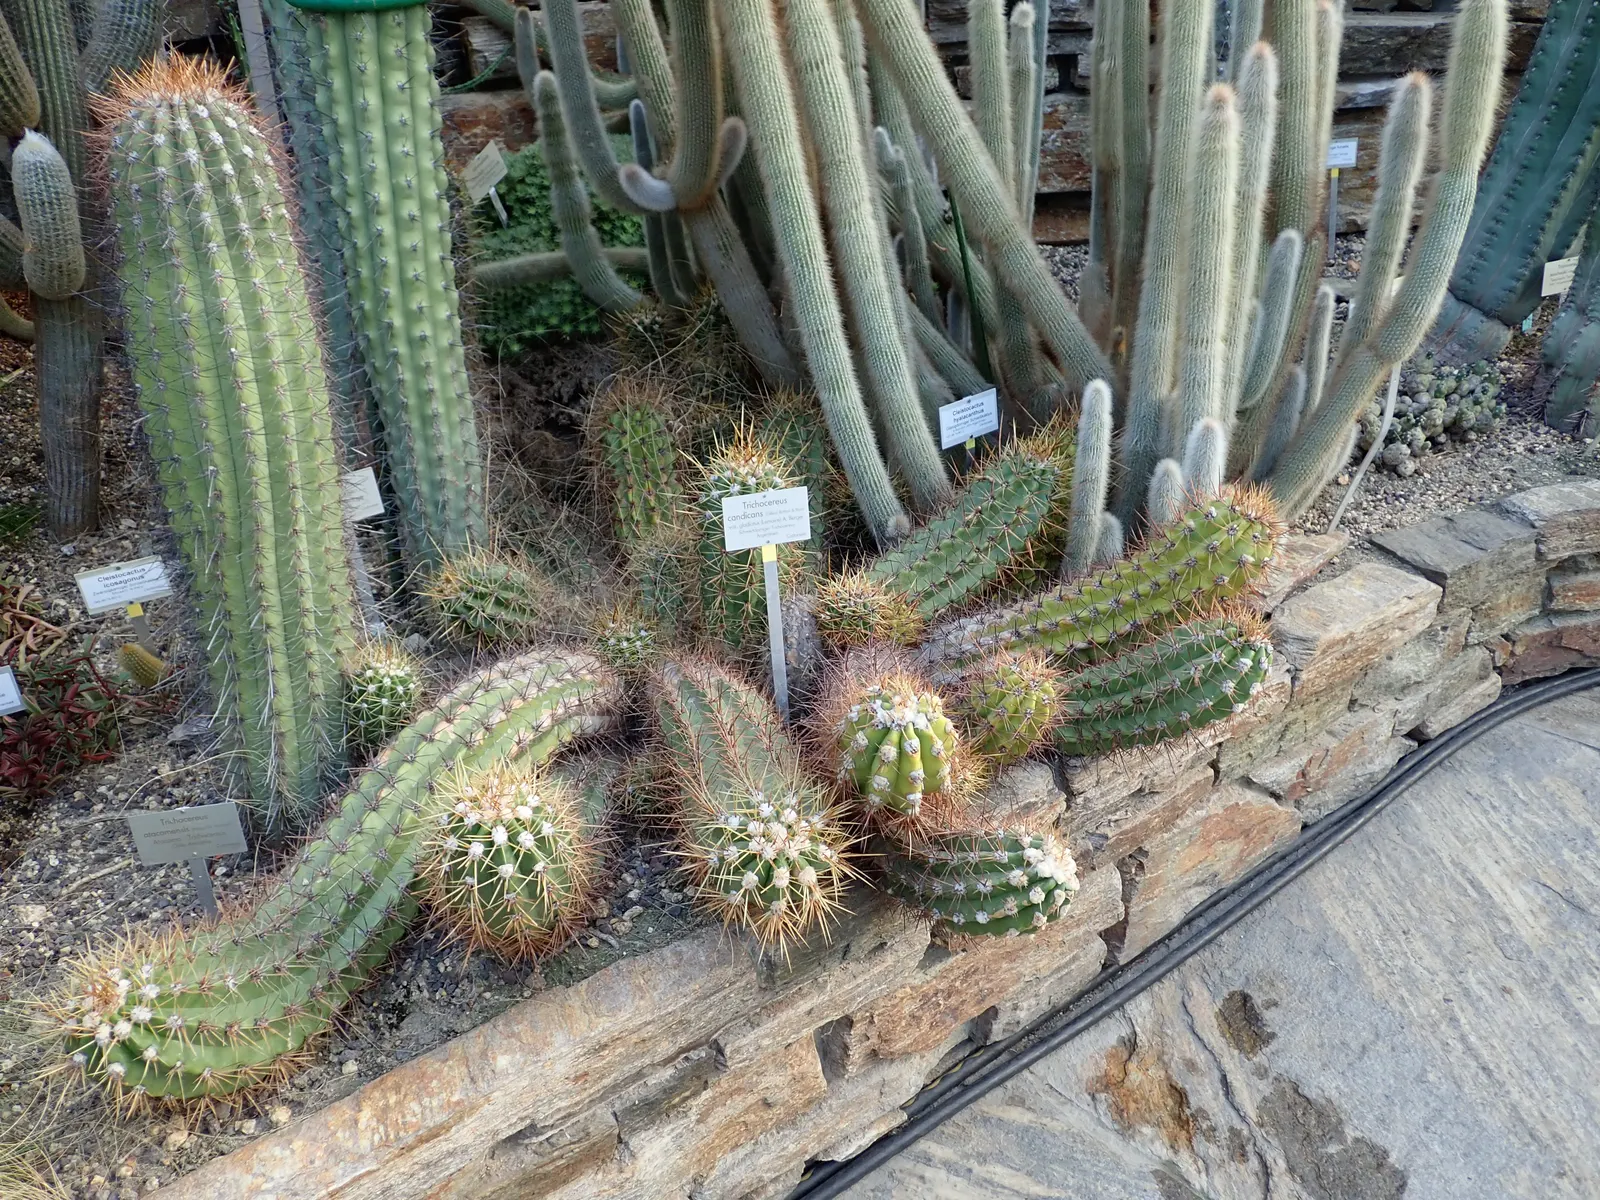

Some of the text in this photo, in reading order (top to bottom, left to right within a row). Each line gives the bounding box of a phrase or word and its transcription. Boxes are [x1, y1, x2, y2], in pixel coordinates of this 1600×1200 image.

[742, 498, 788, 510] Trichocereus
[727, 509, 764, 522] candicans
[97, 567, 146, 583] Cleistocactus
[103, 574, 145, 589] icosagonus
[160, 814, 208, 826] Trichocereus
[143, 826, 190, 839] atacamensis
